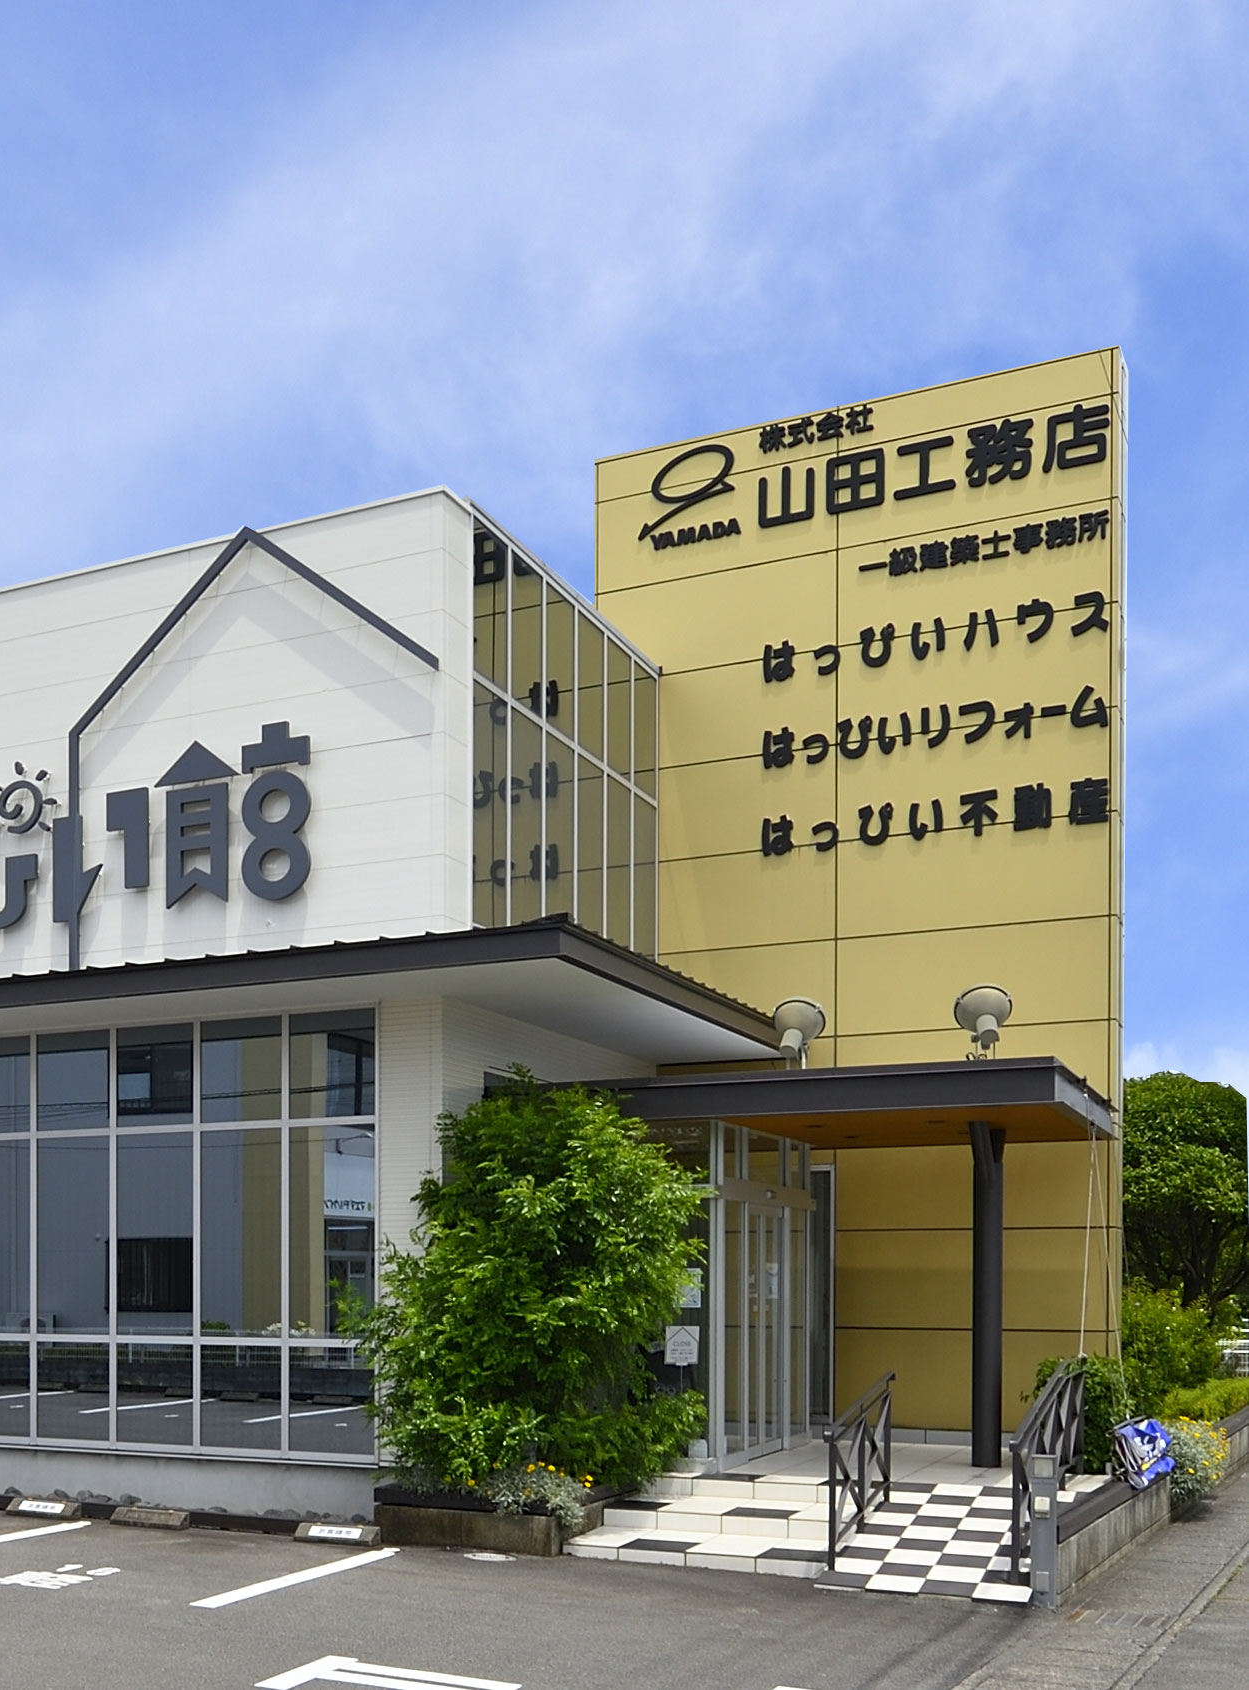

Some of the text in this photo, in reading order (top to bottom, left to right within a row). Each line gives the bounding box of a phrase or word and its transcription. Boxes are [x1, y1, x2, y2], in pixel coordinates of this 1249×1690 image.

[757, 403, 1111, 529] 山田工務店
[758, 404, 874, 454] 株式会社
[650, 517, 742, 551] YAMADA
[858, 508, 1111, 577] 一級建築士事務所
[762, 590, 1110, 683] はっぴいハウス
[762, 685, 1110, 769] はっぴいリフォーム
[760, 777, 1111, 857] はっぴい不動産
